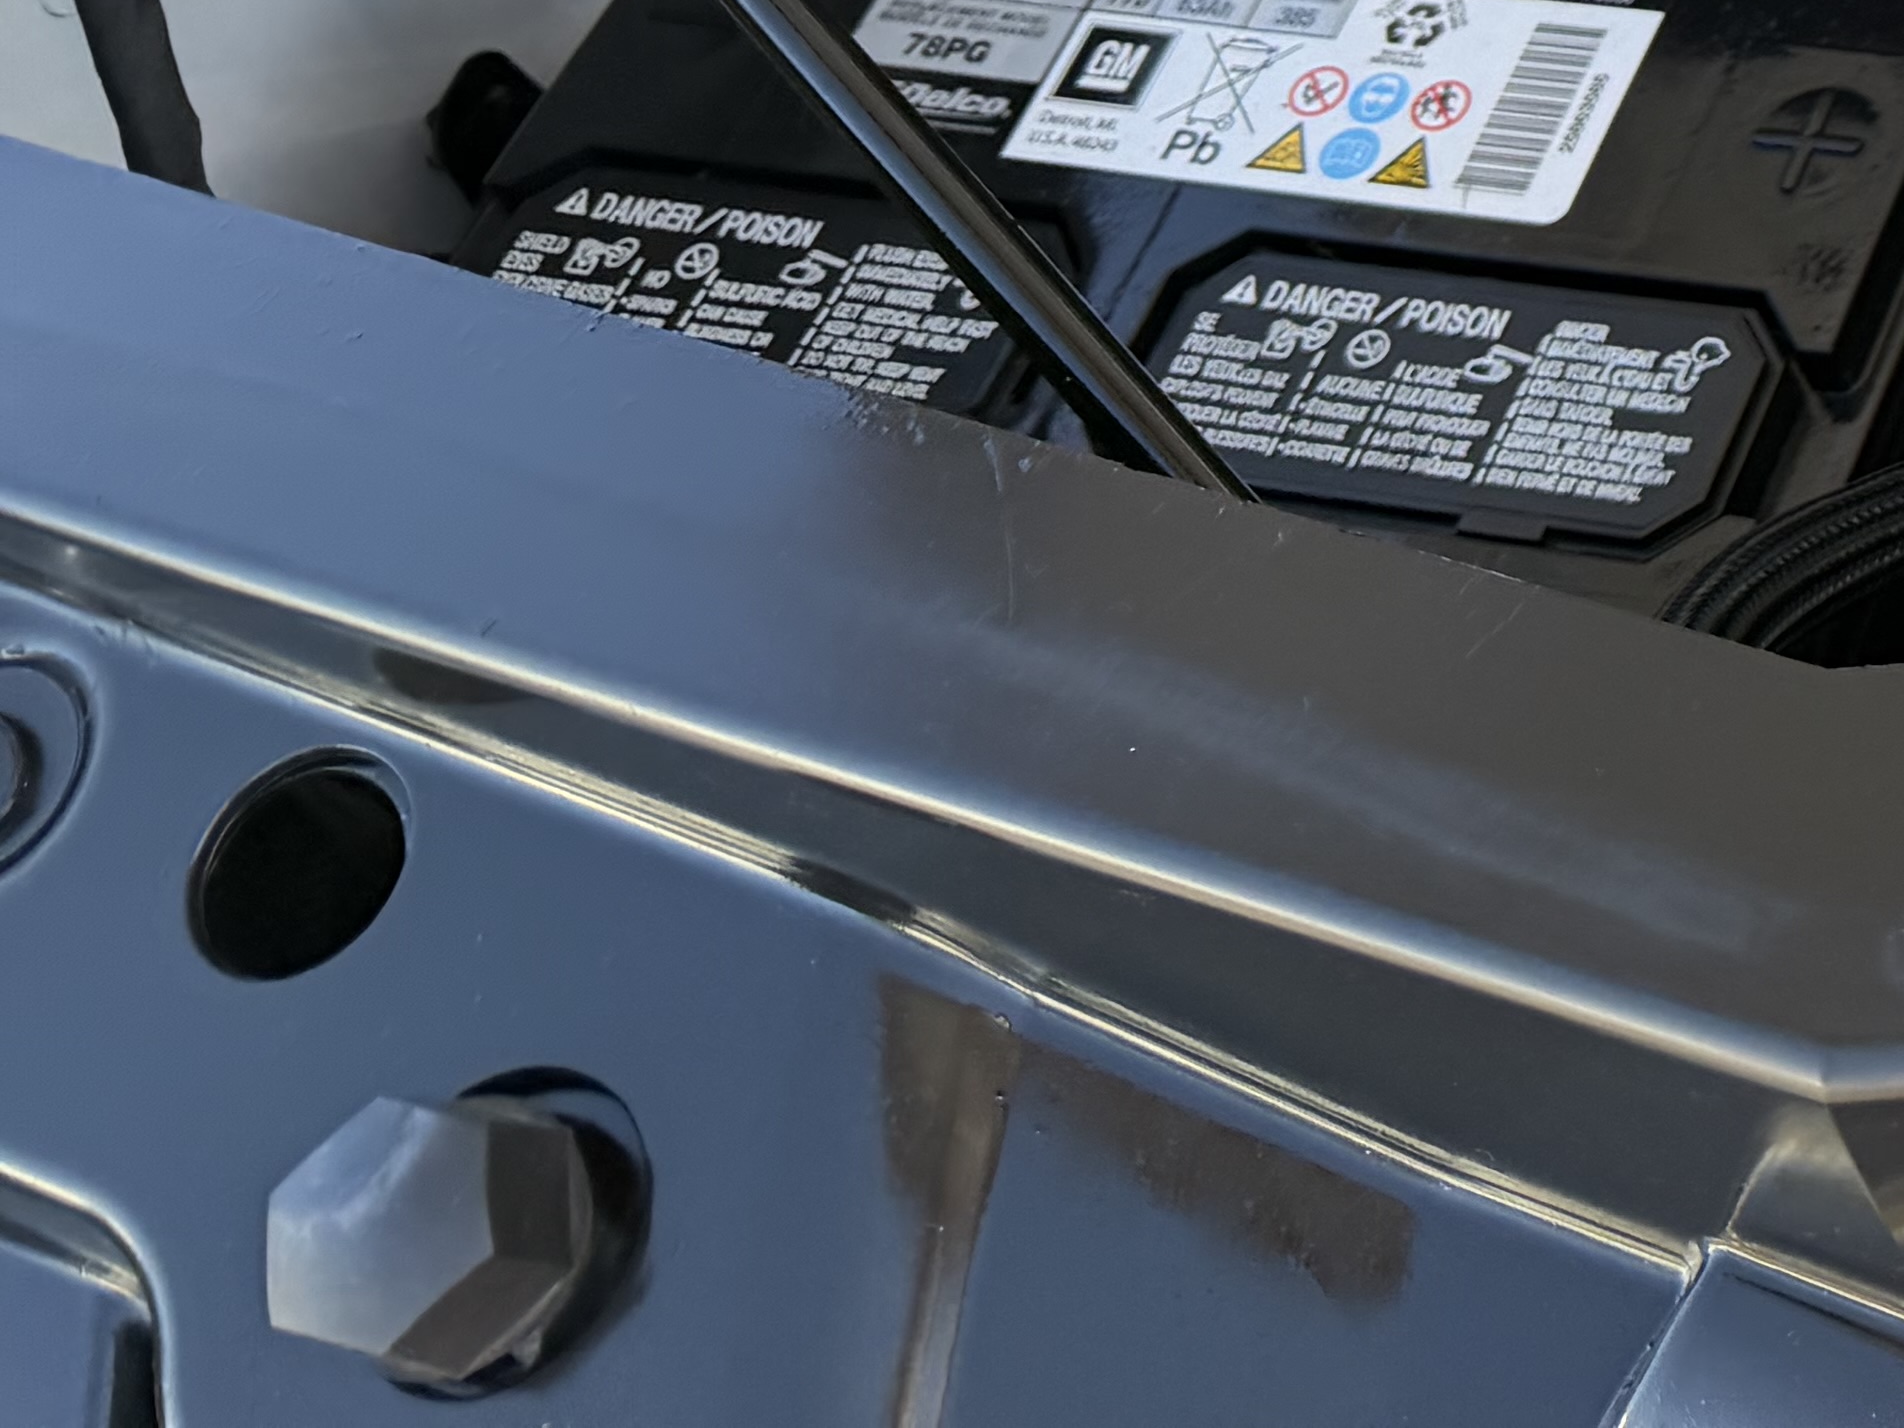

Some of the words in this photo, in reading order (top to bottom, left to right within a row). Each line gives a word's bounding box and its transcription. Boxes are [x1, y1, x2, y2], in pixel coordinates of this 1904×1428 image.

[902, 32, 994, 63] 78PG
[1084, 39, 1151, 80] GM
[1160, 129, 1223, 165] Pb
